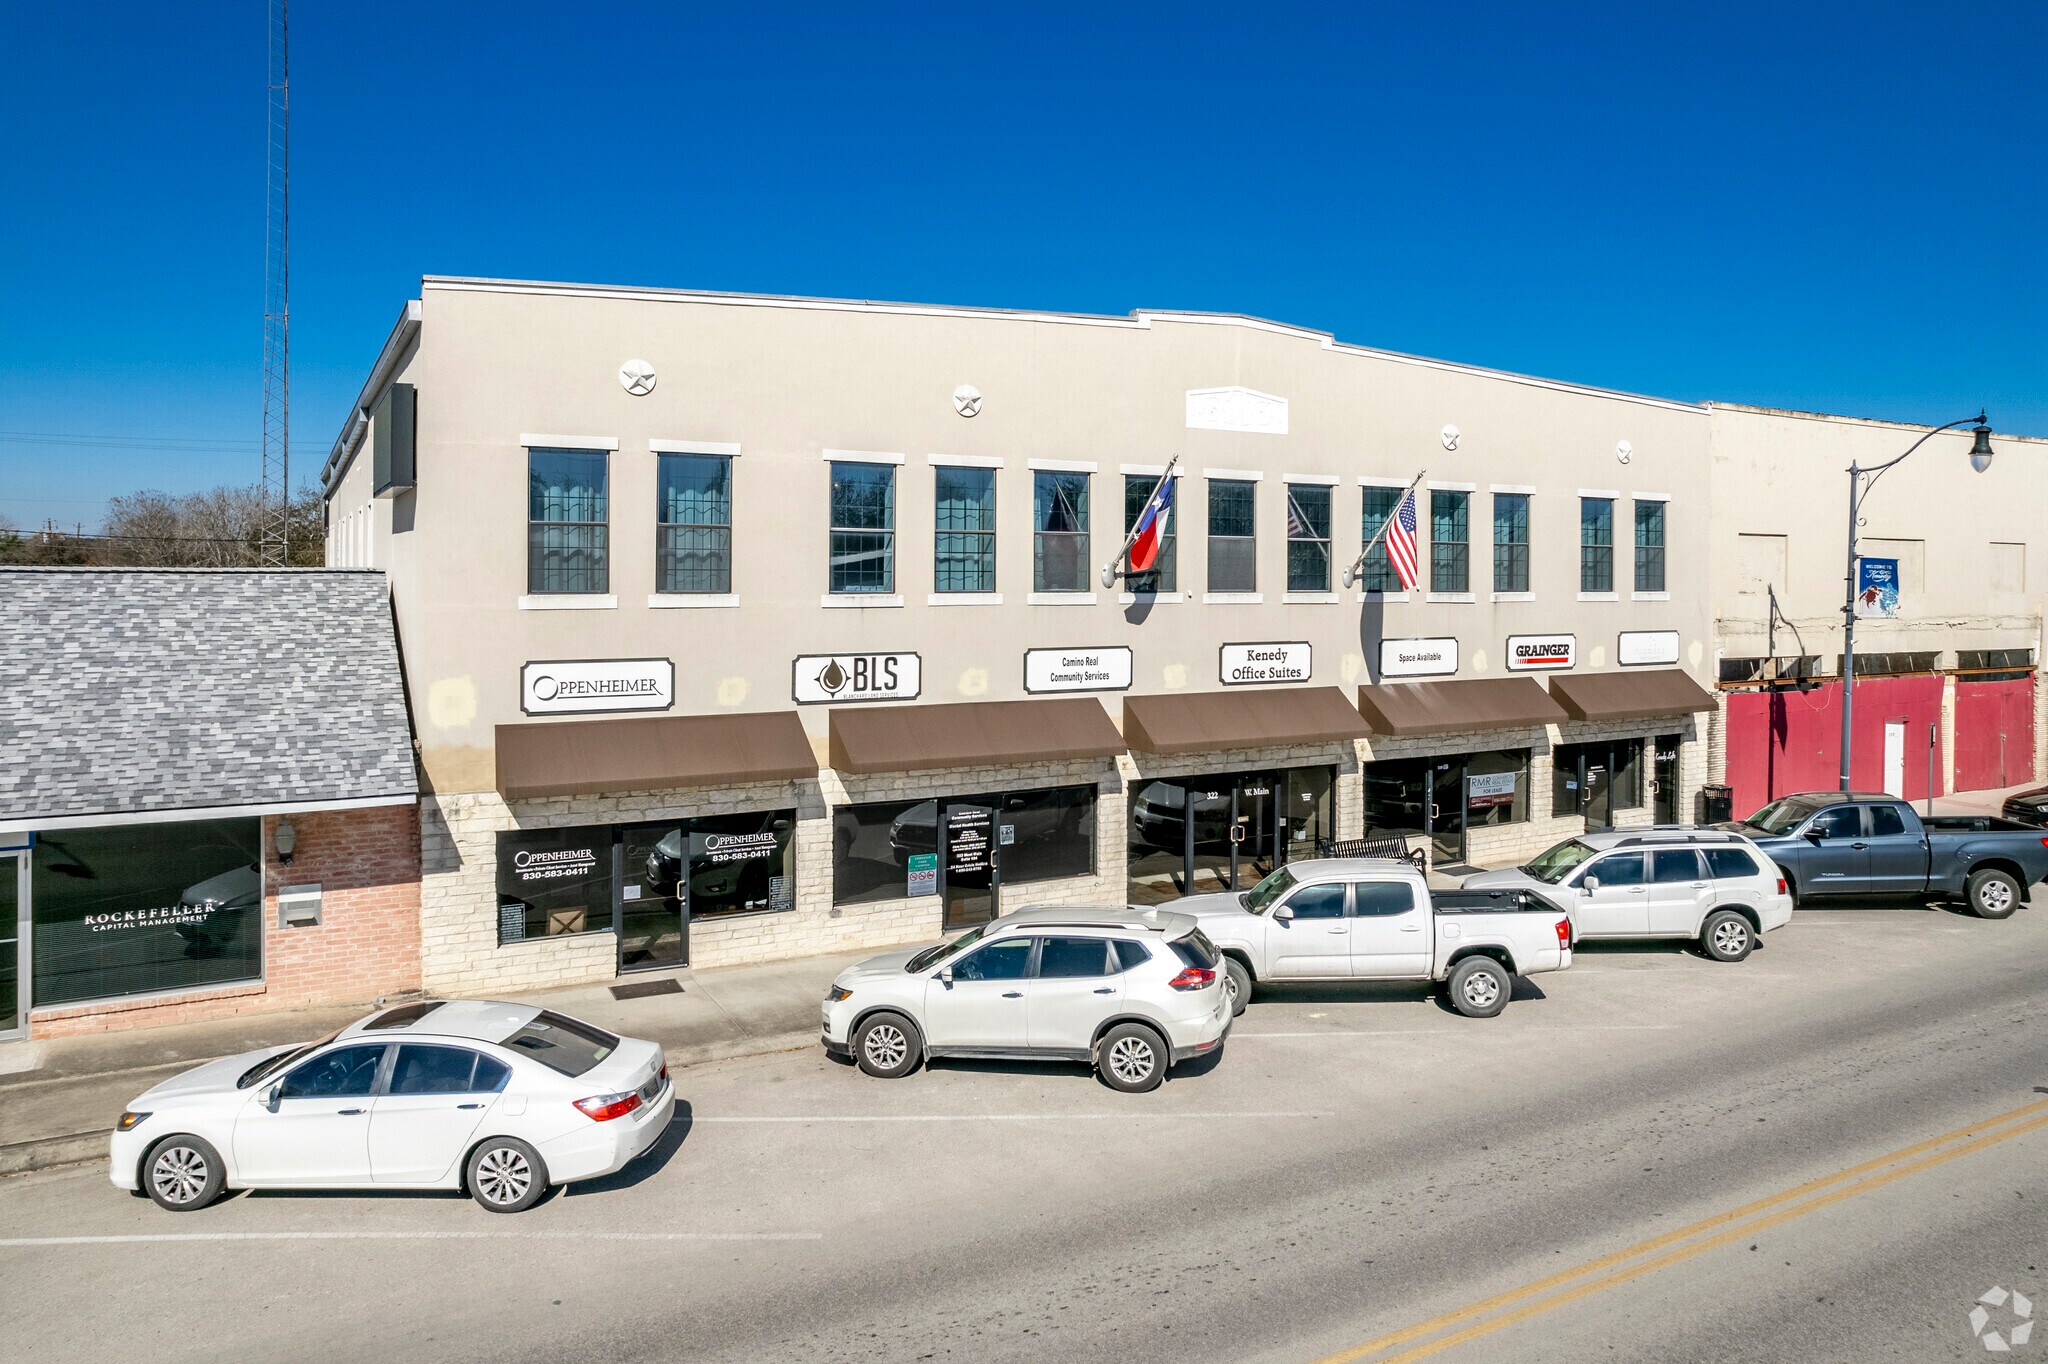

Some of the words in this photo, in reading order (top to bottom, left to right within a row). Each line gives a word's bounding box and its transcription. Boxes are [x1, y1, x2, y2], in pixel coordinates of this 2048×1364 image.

[1247, 648, 1288, 664] Kenedy
[1516, 644, 1570, 657] GRAINGER
[1062, 657, 1085, 667] Camino
[1085, 656, 1099, 666] Real
[1398, 653, 1416, 664] Space
[1416, 652, 1442, 661] Available
[853, 656, 898, 692] BLS
[1050, 671, 1083, 683] Community
[1084, 671, 1110, 681] Services
[1232, 666, 1266, 680] Office
[1269, 667, 1302, 679] Suites
[533, 675, 664, 701] OPPENHEIMER
[1471, 776, 1492, 787] RMR
[1206, 791, 1219, 800] 322
[1253, 787, 1270, 795] Main
[705, 832, 778, 850] OPPENHEIMER
[514, 849, 596, 867] OPPENHEIMER
[712, 849, 771, 862] 830-583-0411
[522, 867, 588, 880] 830-583-0411
[84, 903, 216, 925] ROCKEFELLER
[92, 922, 136, 932] CAPITAL
[139, 914, 208, 927] MANAGEMENT
